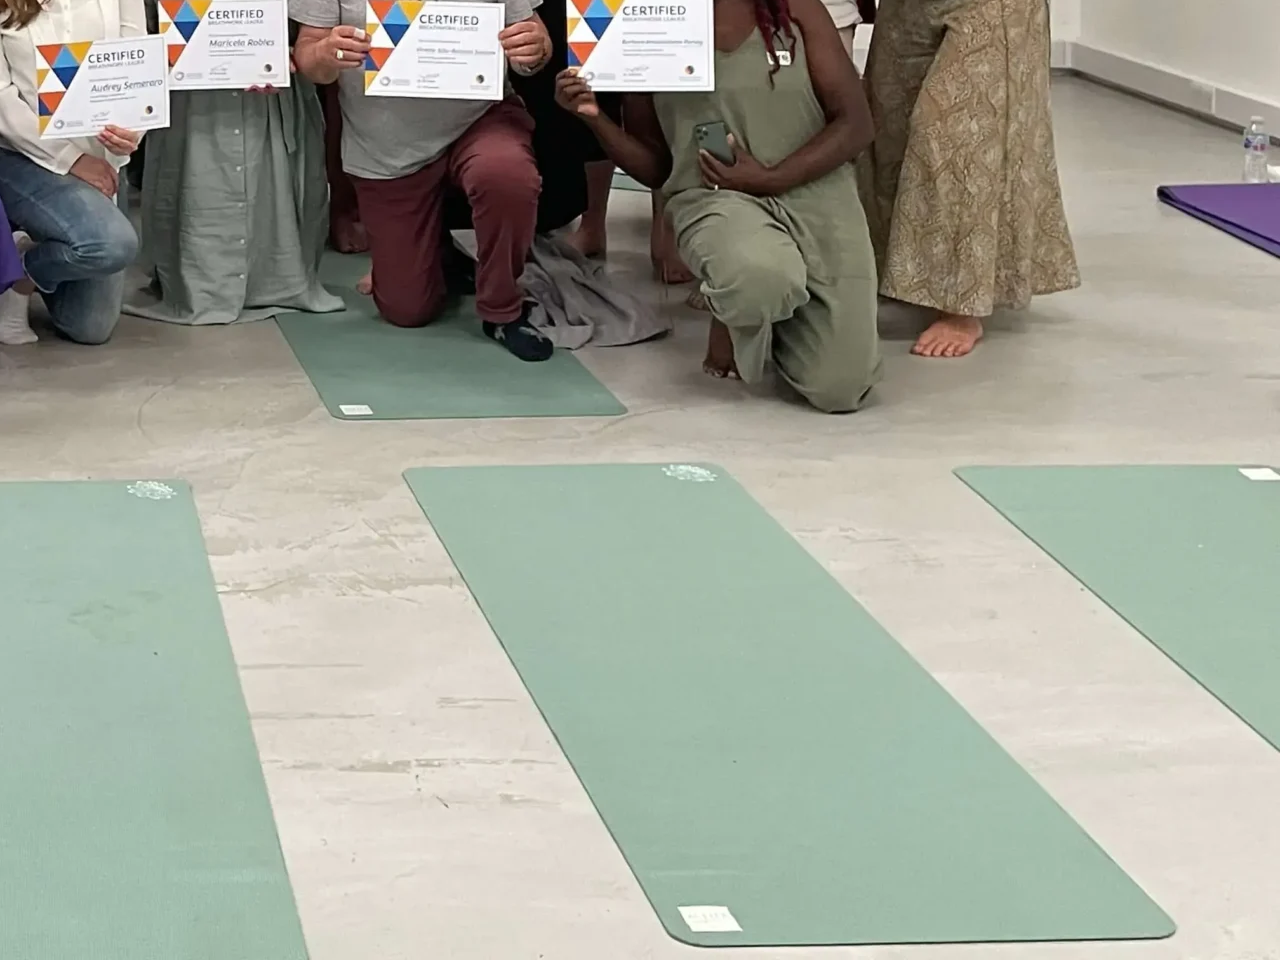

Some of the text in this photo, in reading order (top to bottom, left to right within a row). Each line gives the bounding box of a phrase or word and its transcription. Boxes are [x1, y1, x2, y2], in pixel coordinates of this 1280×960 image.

[208, 9, 264, 20] CERTIFIED
[622, 5, 687, 16] CERTIFIED
[419, 14, 480, 26] CERTIFIED
[209, 38, 275, 48] Maricela Robles
[88, 49, 145, 64] CERTIFIED
[90, 78, 164, 93] Audrey Semeraro
